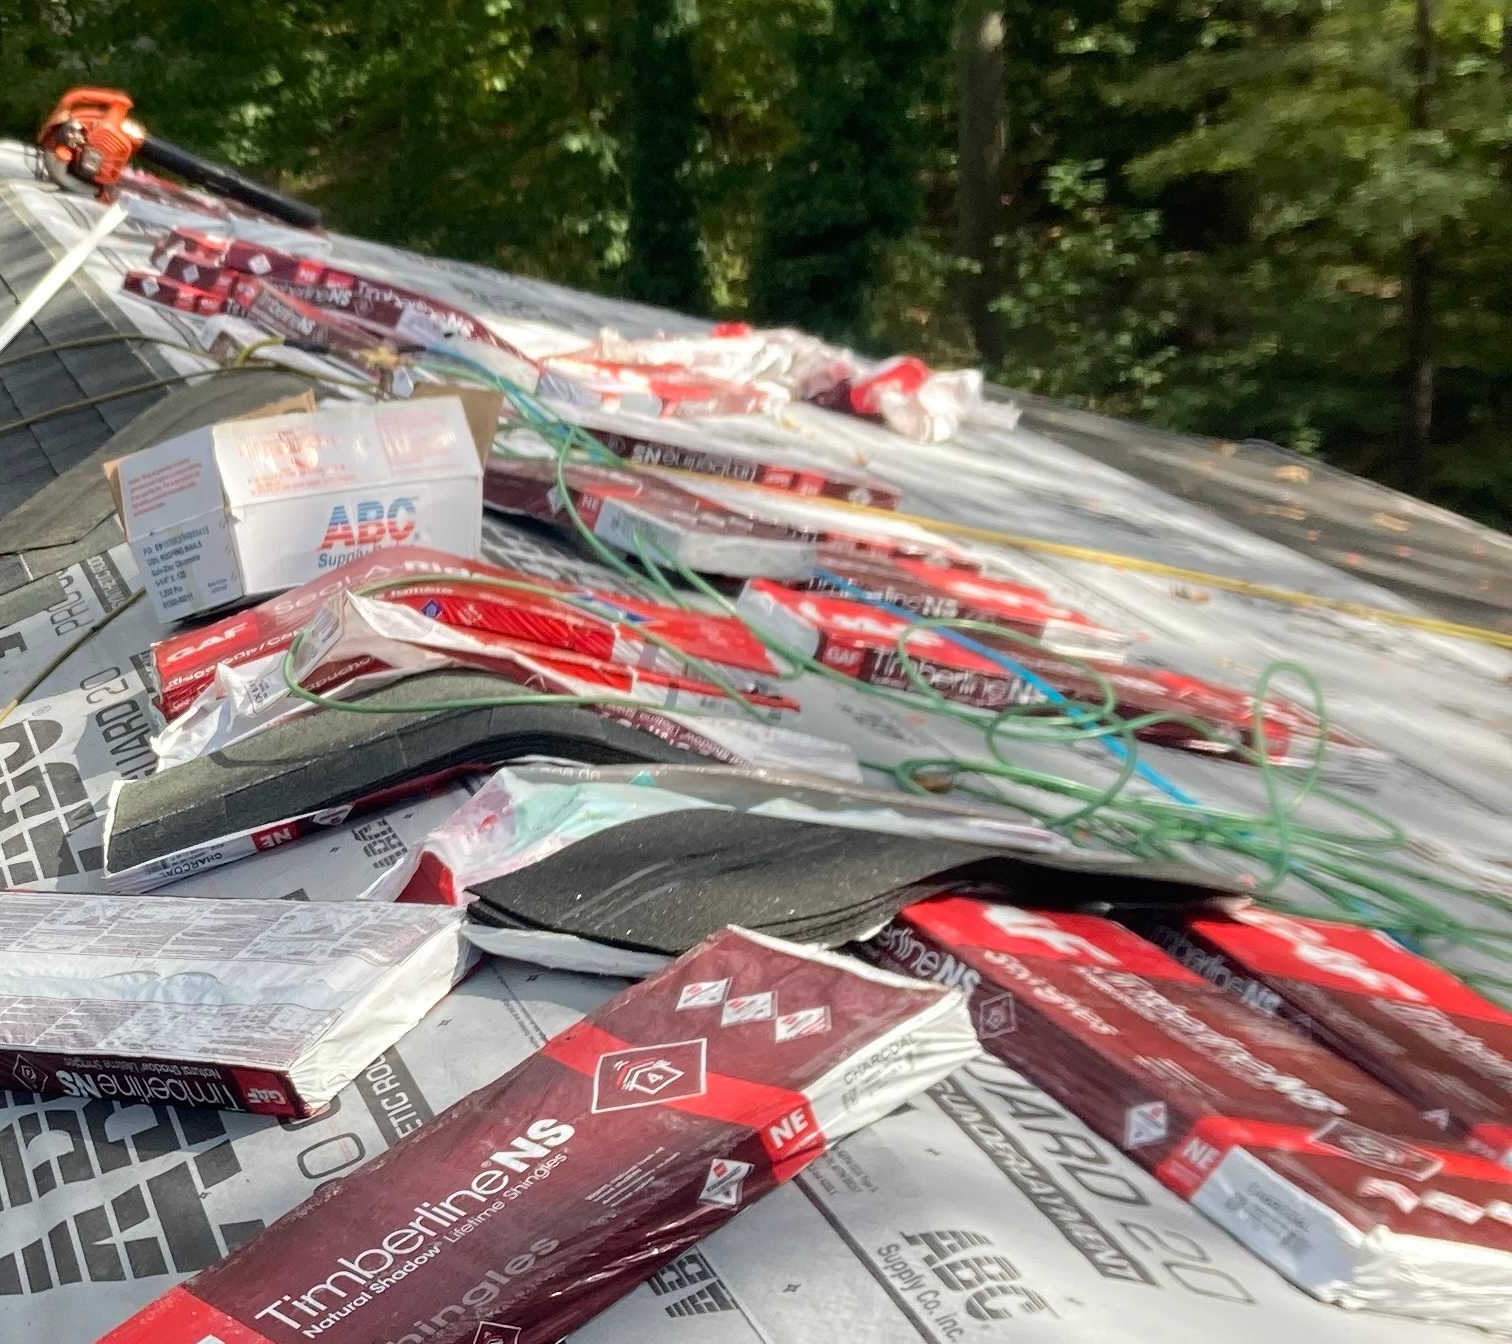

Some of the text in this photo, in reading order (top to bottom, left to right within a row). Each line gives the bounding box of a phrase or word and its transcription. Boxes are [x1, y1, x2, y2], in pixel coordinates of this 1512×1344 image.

[316, 497, 419, 551] ABC
[166, 621, 248, 663] GAF
[259, 828, 293, 847] NE
[937, 959, 982, 995] NS
[55, 1067, 246, 1111] NS Timberline
[246, 1087, 286, 1105] GAF
[767, 1107, 810, 1150] NE
[1181, 1136, 1223, 1171] NE
[254, 1168, 510, 1331] Timberline
[491, 1118, 576, 1175] NS
[302, 1291, 373, 1339] Natural
[368, 1244, 441, 1295] Shadow
[444, 1198, 506, 1244] Lifetime
[502, 1152, 568, 1200] Shingles
[876, 1243, 967, 1344] Supply Co. Inc.
[899, 1229, 1059, 1322] ABC
